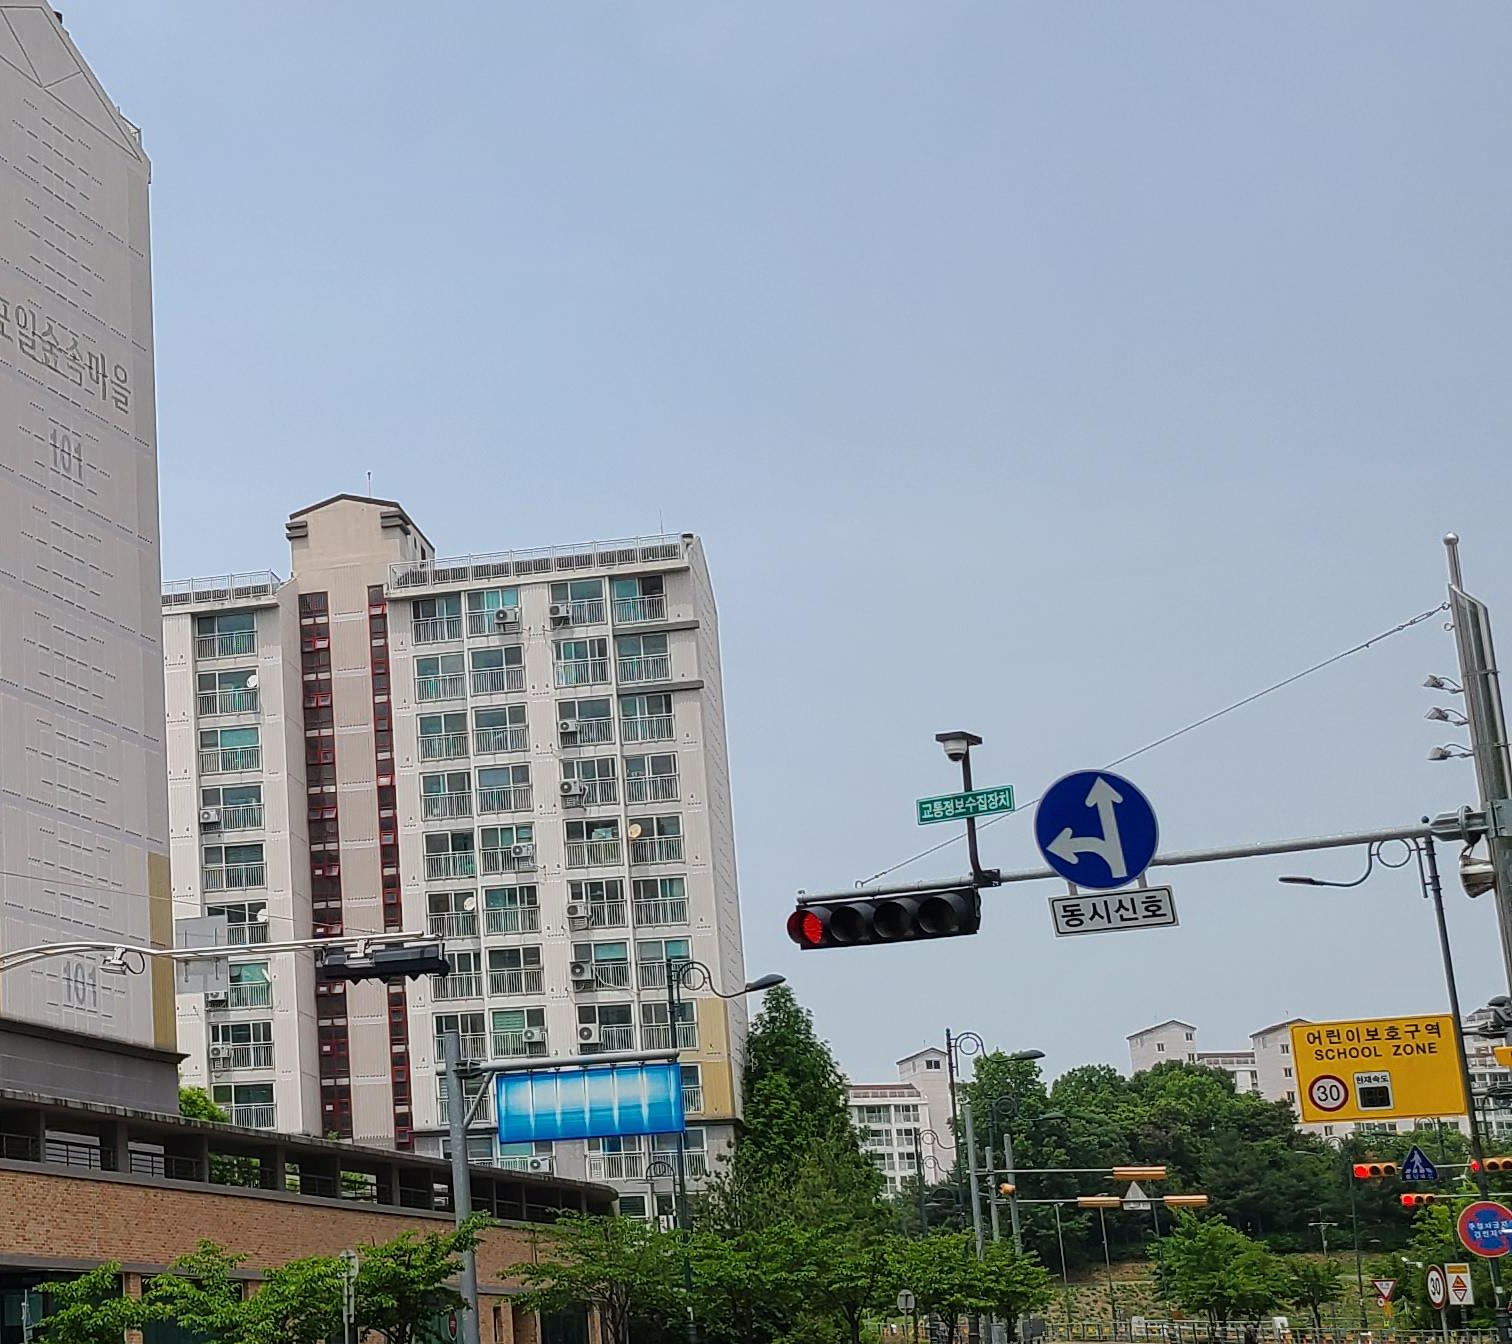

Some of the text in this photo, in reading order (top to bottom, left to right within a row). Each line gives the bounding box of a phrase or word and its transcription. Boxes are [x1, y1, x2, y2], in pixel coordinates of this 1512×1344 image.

[49, 428, 84, 483] 101
[921, 790, 1010, 818] 교통정보수집장치
[1061, 895, 1167, 927] 동시신호
[62, 960, 97, 1008] 101
[1306, 1021, 1442, 1046] 어린이보호구역
[1314, 1042, 1438, 1061] SCHOOL ZONE
[1316, 1084, 1341, 1102] 30
[1430, 1277, 1441, 1296] 30
